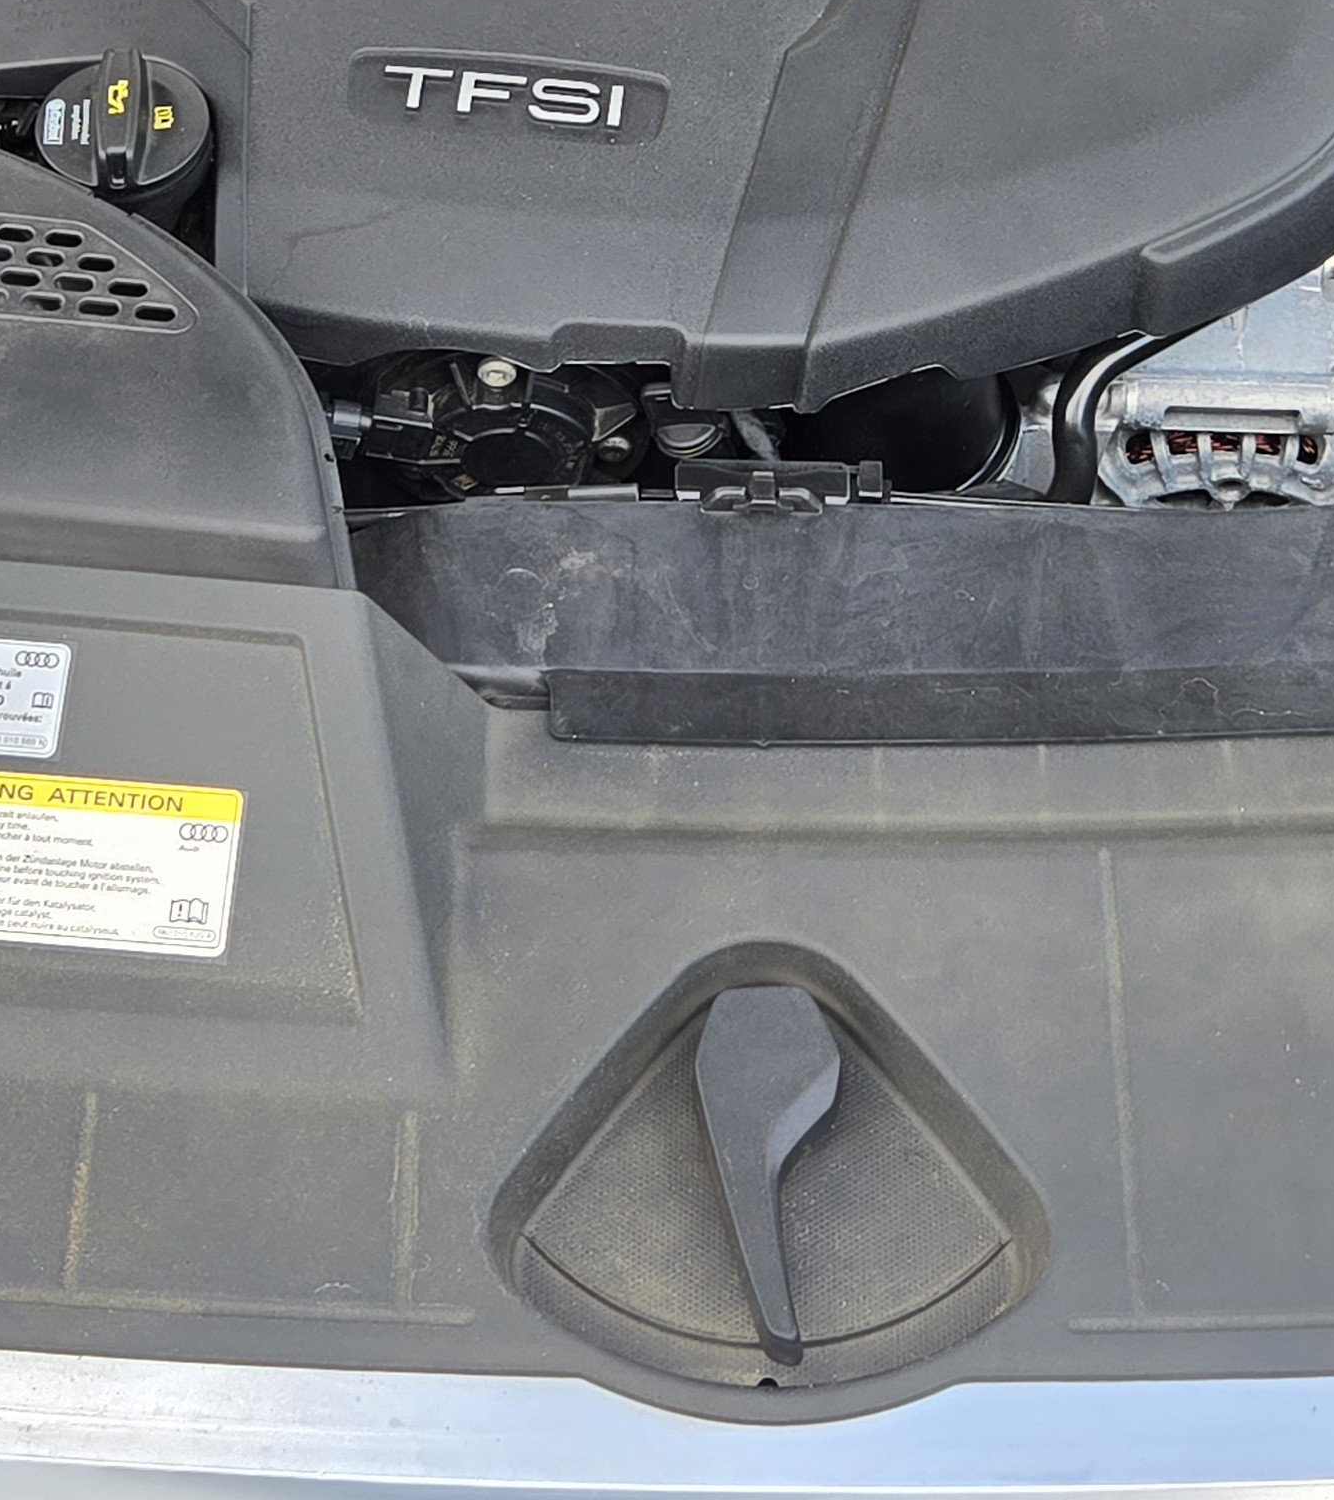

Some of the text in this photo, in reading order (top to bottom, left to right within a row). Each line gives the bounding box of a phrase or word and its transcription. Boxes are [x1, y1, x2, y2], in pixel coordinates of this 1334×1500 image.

[384, 64, 624, 127] TFSI
[47, 787, 183, 812] ATTENTION
[45, 868, 86, 880] touching
